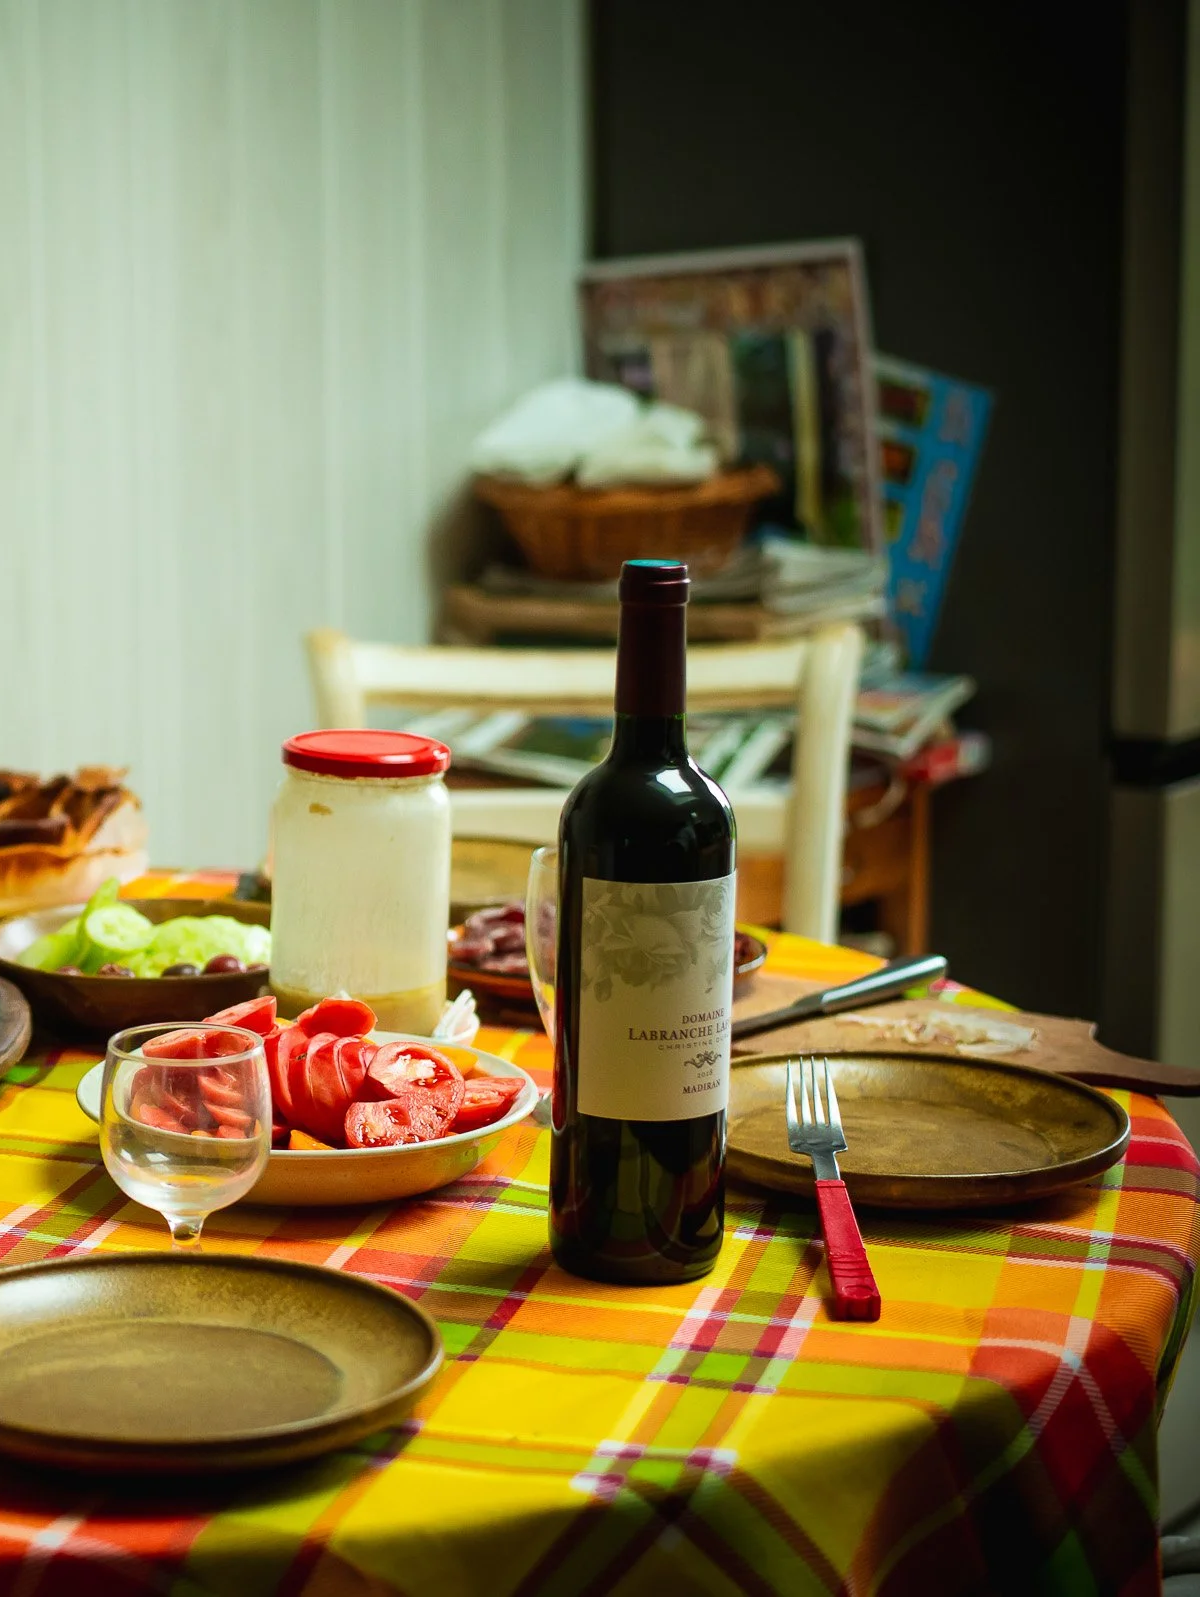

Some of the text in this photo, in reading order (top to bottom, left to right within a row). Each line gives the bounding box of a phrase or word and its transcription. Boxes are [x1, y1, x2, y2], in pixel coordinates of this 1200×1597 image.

[682, 1008, 724, 1024] DOMAINE
[628, 1025, 712, 1040] LABRANCHE
[658, 1039, 712, 1050] CHRISTINE
[682, 1079, 720, 1094] MADIRAN
